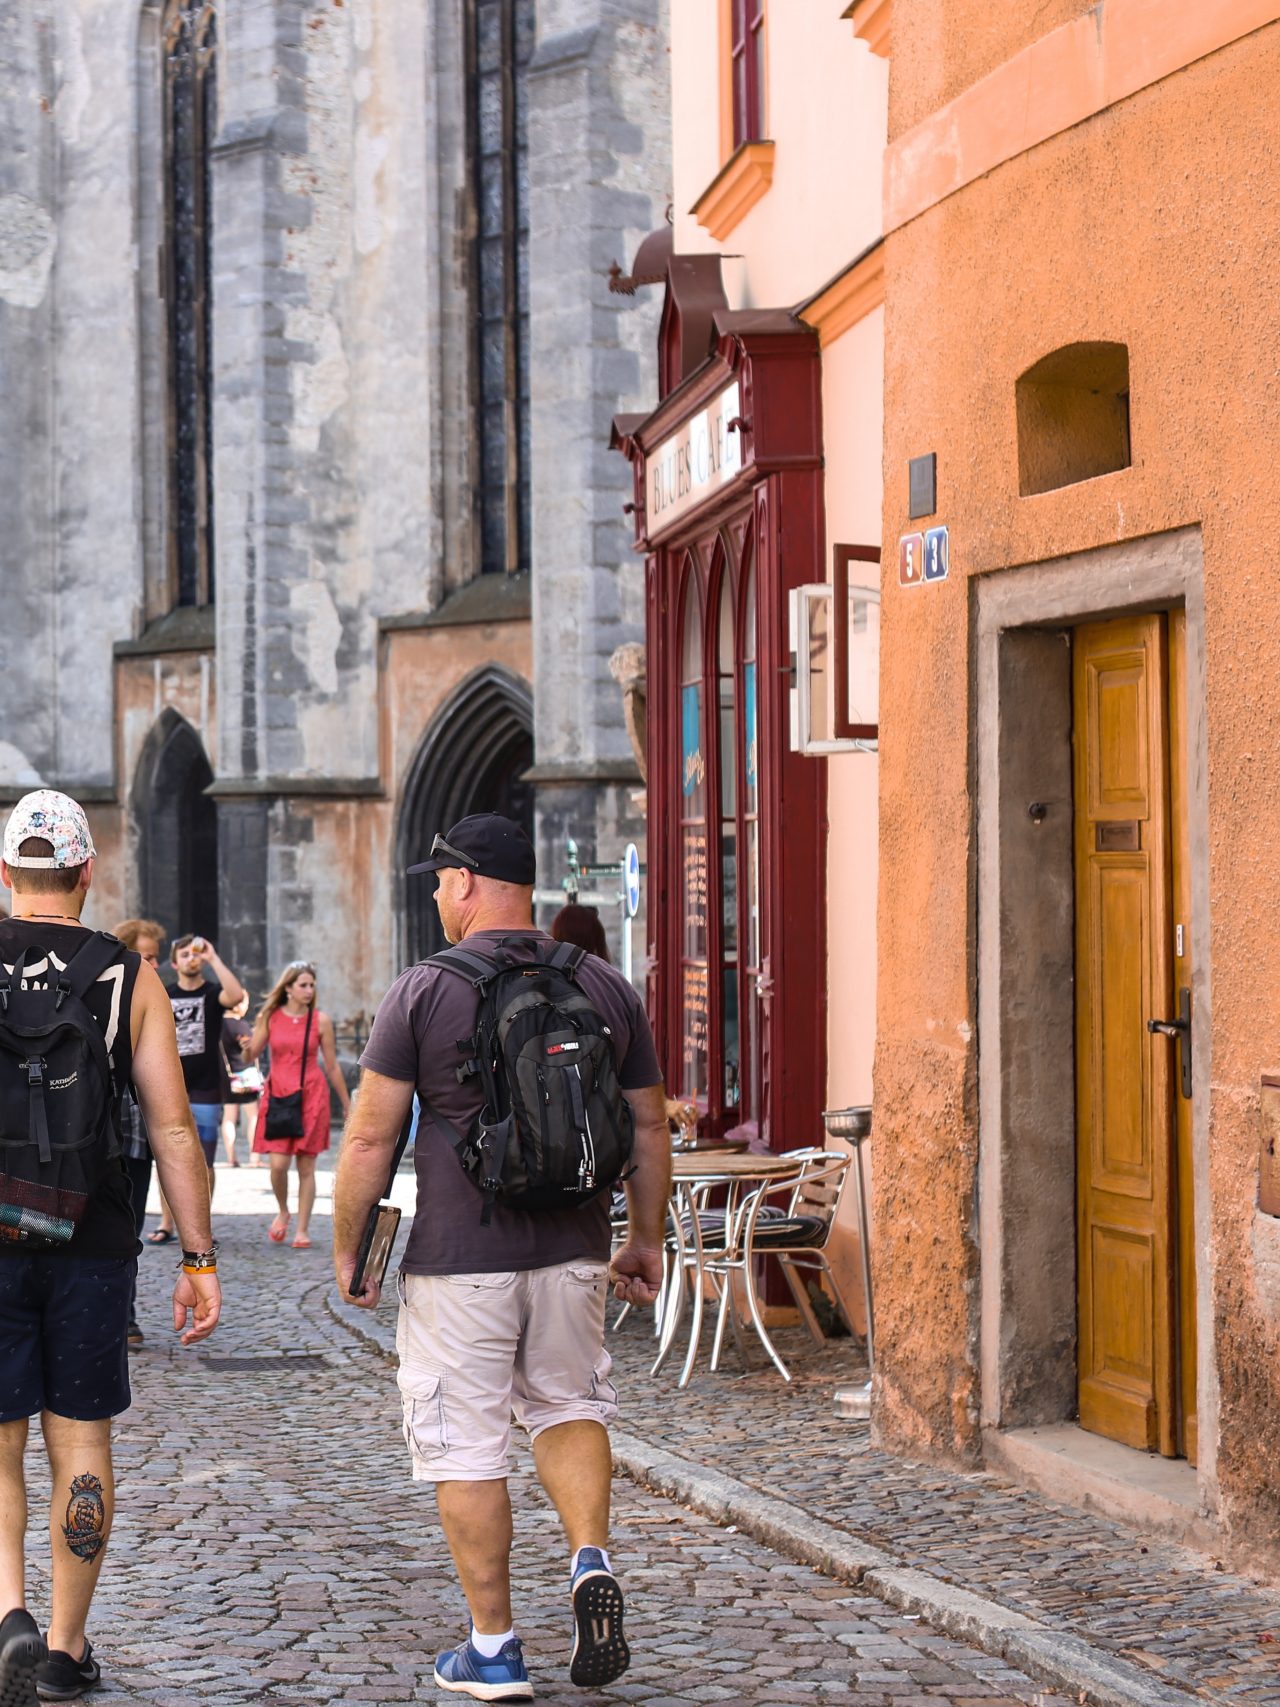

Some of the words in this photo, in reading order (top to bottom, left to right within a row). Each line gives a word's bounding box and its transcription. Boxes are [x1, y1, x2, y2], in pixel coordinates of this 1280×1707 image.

[653, 440, 692, 516] BLUES
[906, 542, 915, 579] 5
[931, 535, 939, 573] 3
